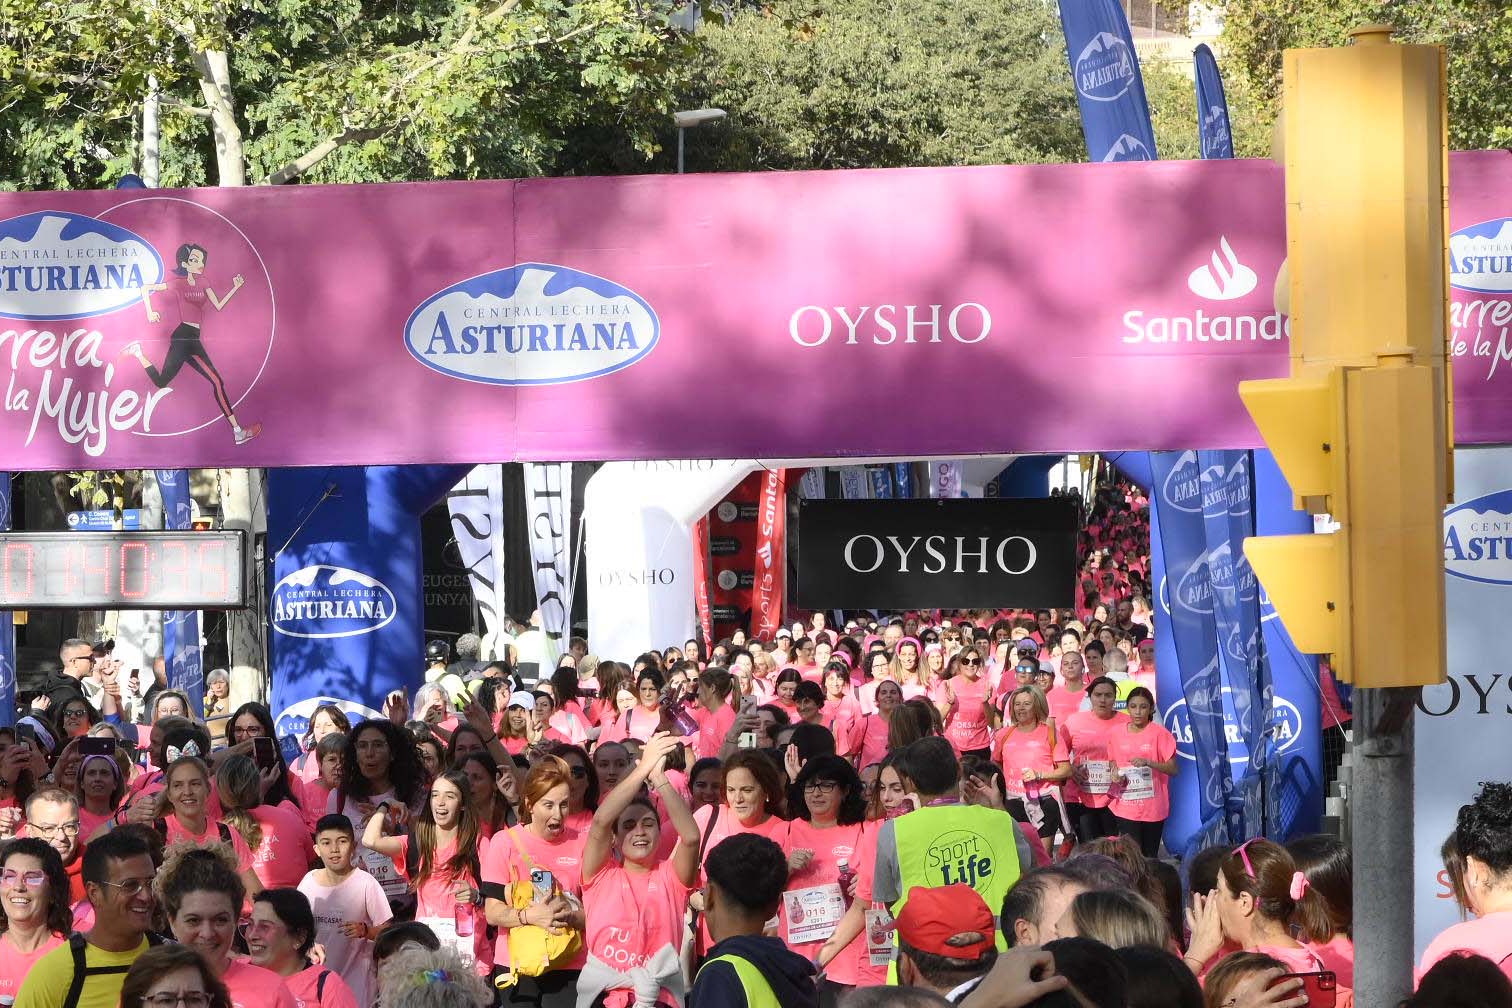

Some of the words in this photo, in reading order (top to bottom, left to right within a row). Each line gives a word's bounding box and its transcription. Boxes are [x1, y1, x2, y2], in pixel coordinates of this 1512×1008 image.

[67, 247, 139, 258] LECHERA
[464, 306, 541, 318] CENTRAL
[551, 304, 631, 316] LECHERA
[789, 302, 992, 346] OYSHO
[424, 311, 640, 355] ASTURIANA
[5, 370, 29, 411] la
[25, 363, 174, 457] Mujer
[844, 534, 1037, 575] OYSHO
[274, 595, 387, 622] ASTURIANA
[287, 590, 329, 598] CENTRAL
[333, 589, 383, 598] LECHERA
[929, 835, 980, 868] Sport
[941, 854, 992, 889] Life
[610, 926, 630, 944] TU
